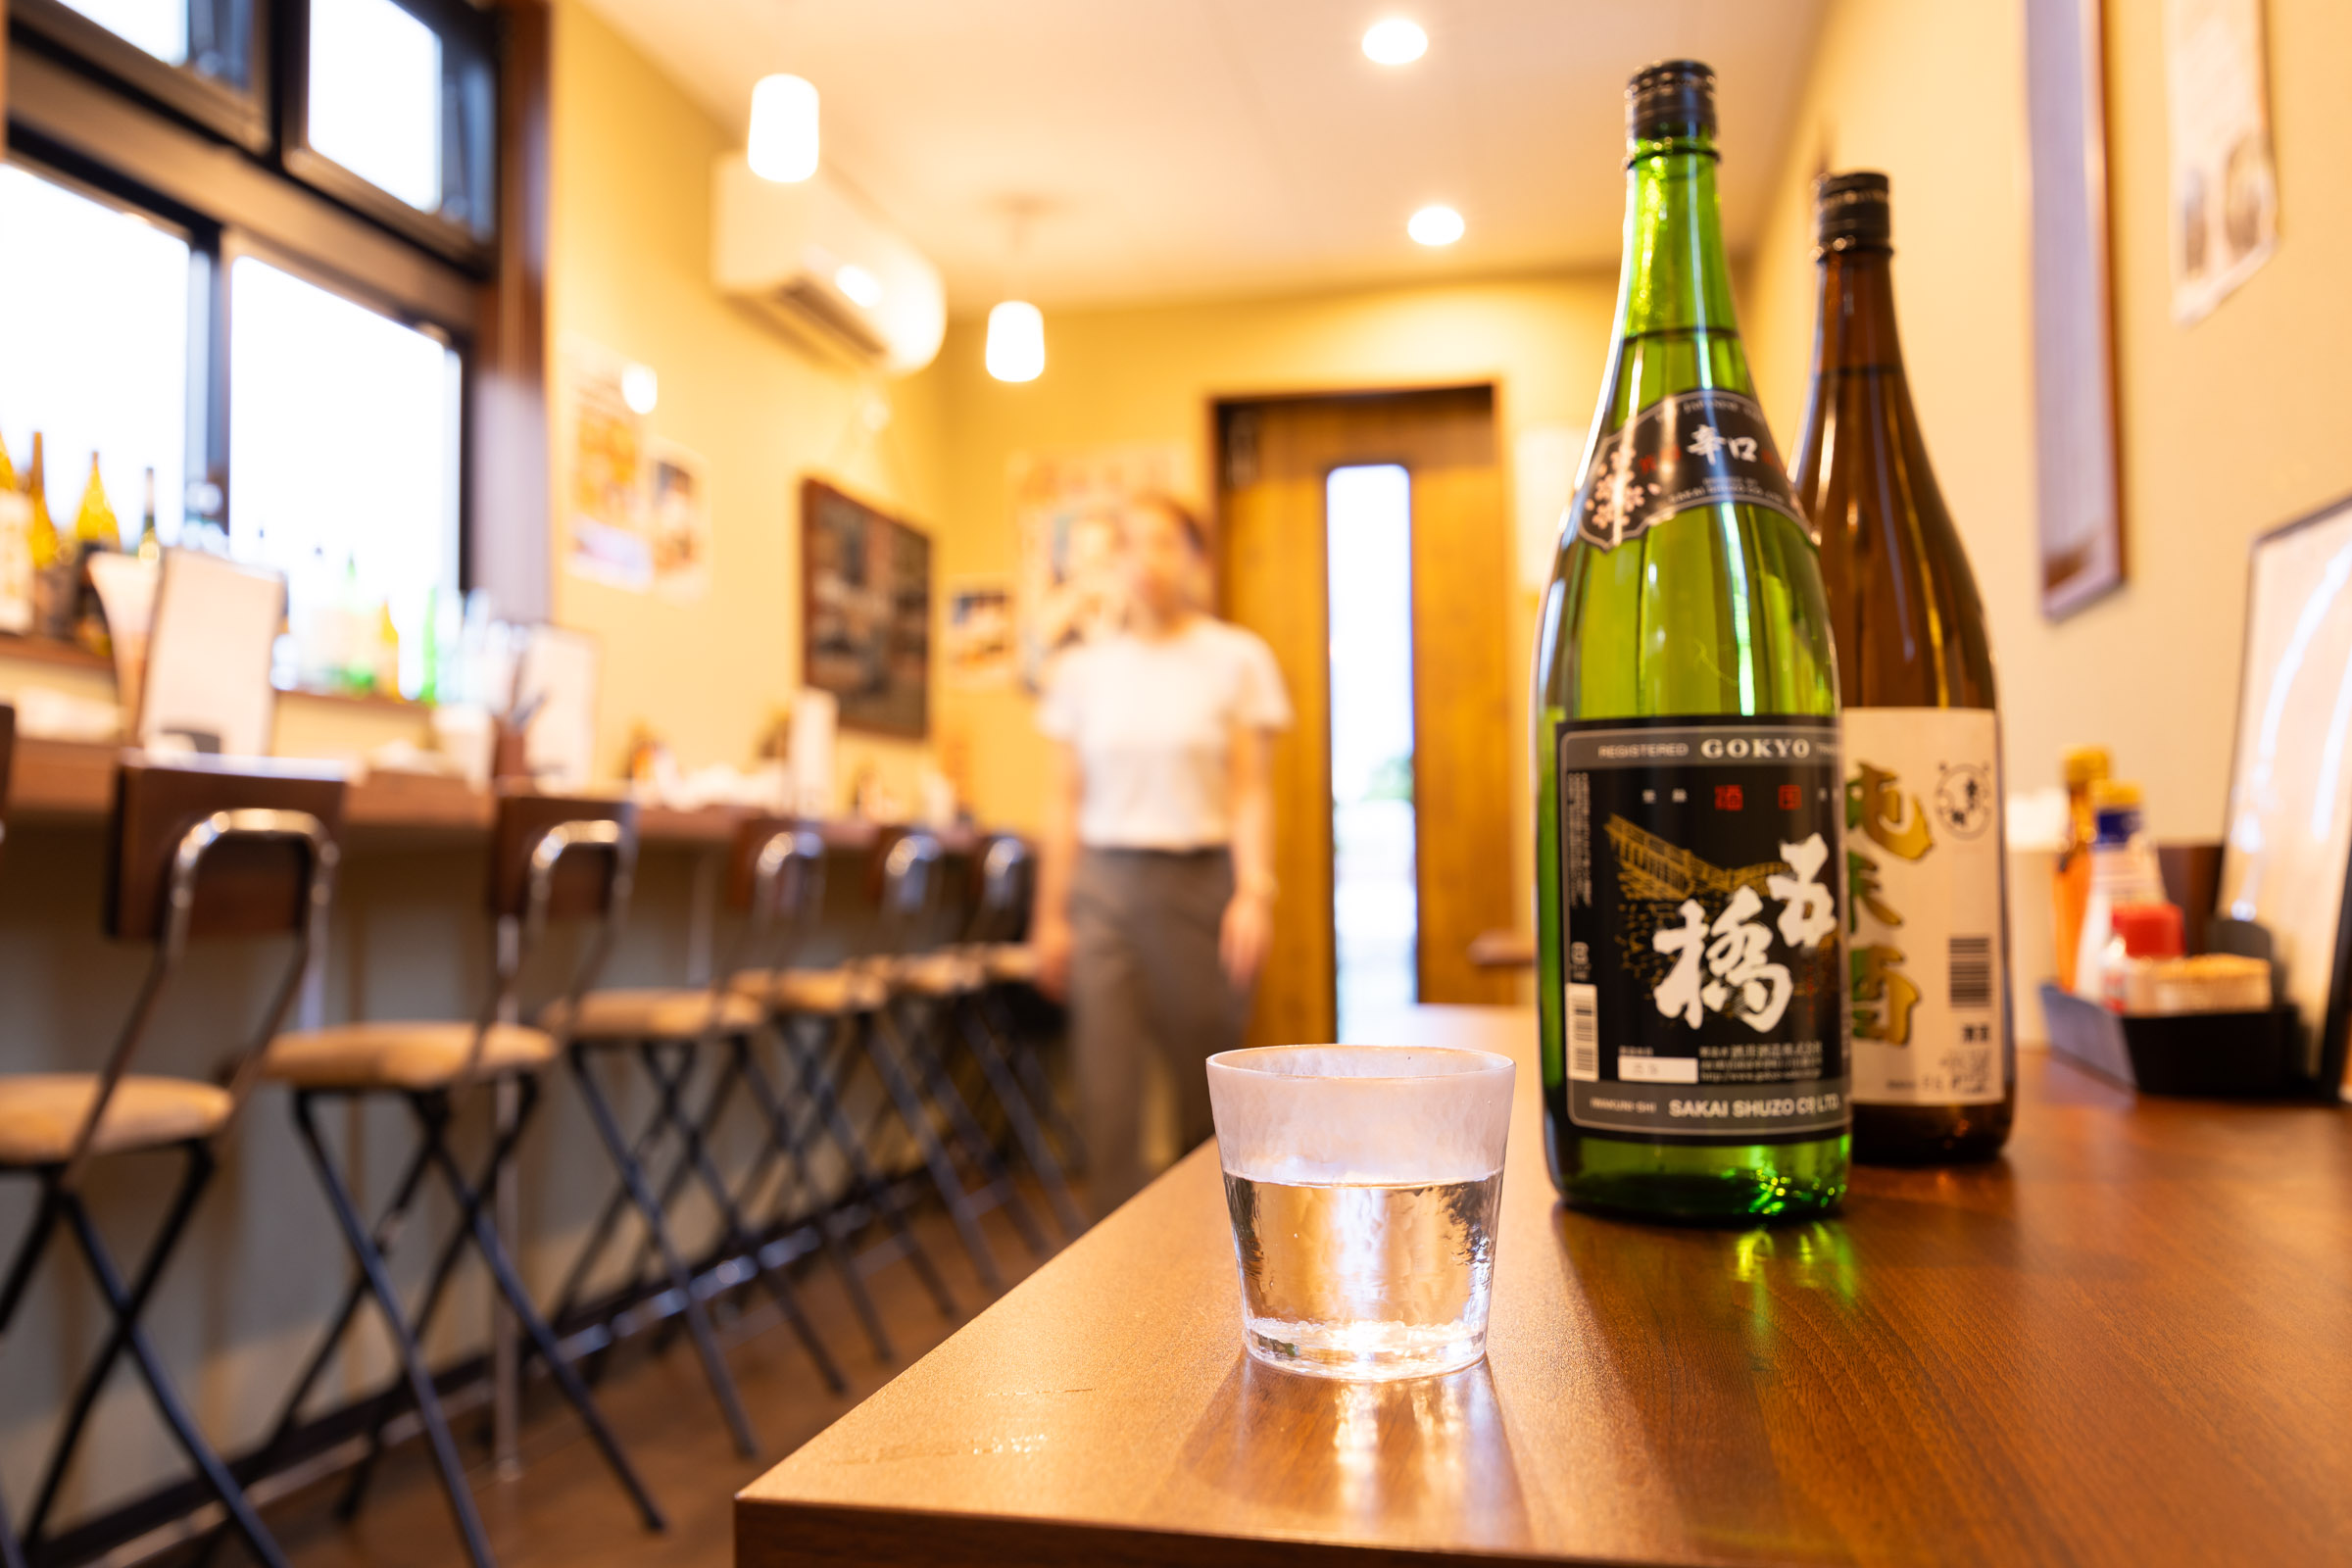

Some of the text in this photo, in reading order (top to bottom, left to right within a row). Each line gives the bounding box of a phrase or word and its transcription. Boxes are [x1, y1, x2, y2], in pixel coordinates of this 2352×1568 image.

[1687, 423, 1758, 466] 辛口
[1597, 742, 1690, 760] REGISTERED
[1700, 738, 1810, 759] GOKYO
[1669, 1099, 1729, 1118] SAKAI
[1732, 1097, 1795, 1118] SHUZO
